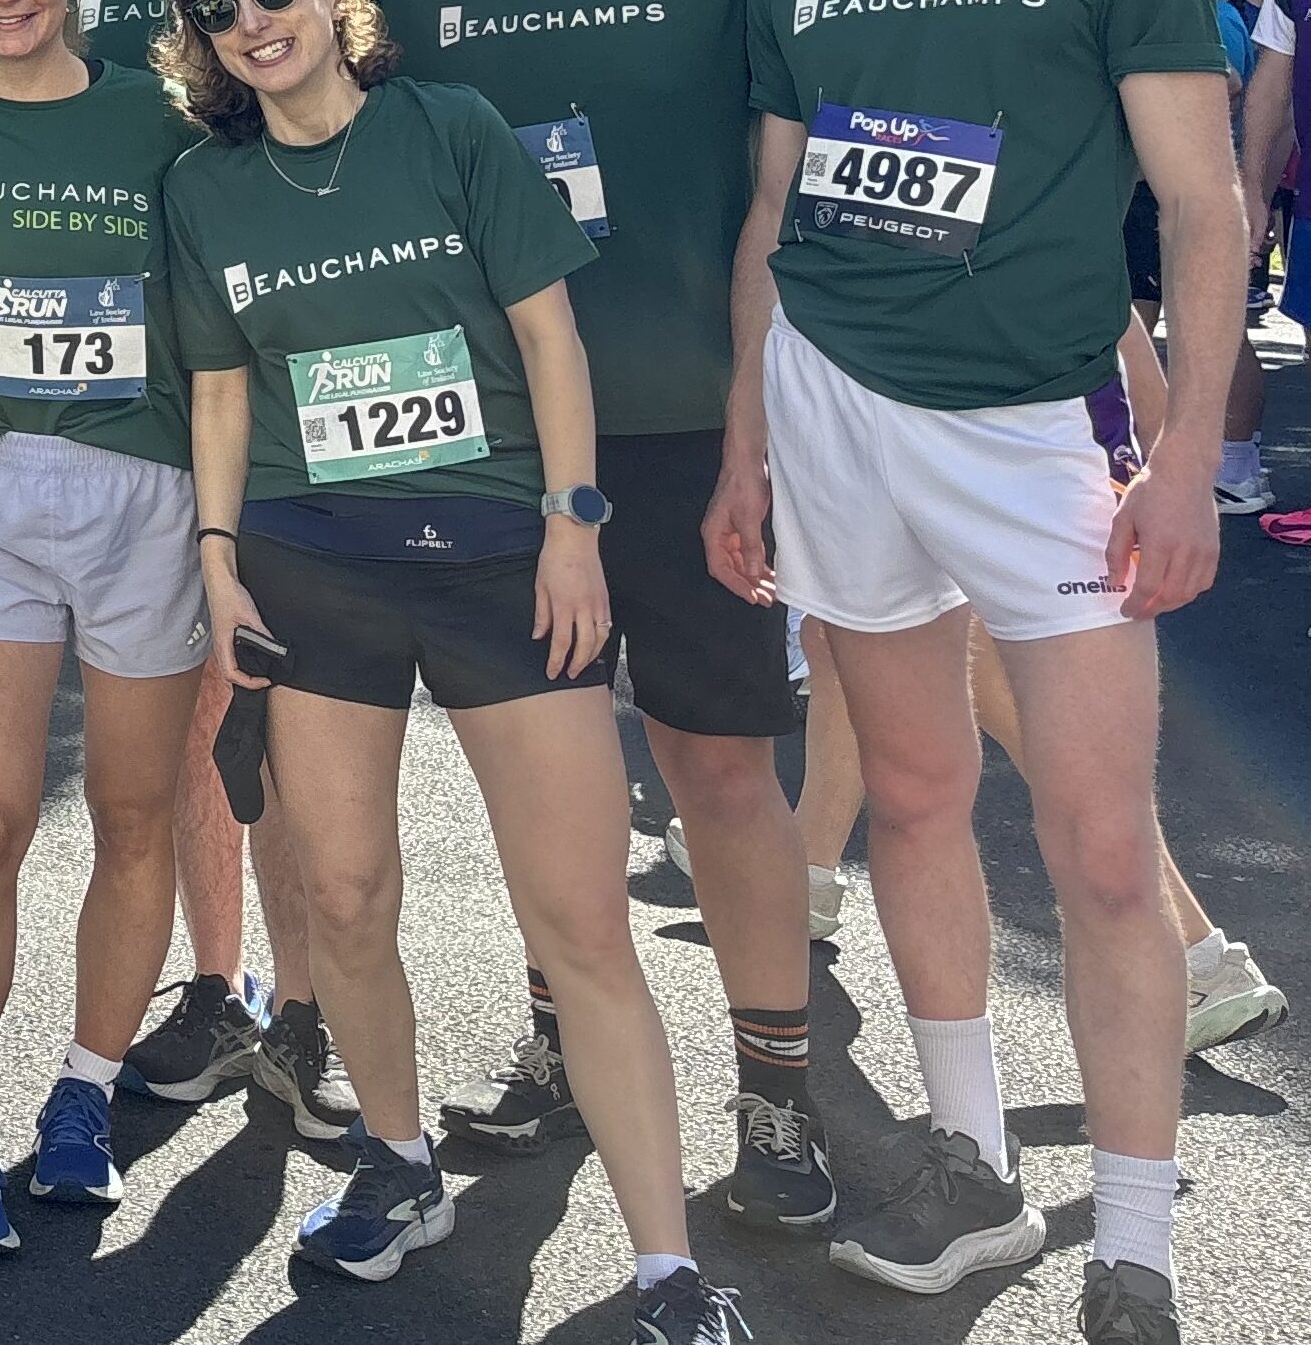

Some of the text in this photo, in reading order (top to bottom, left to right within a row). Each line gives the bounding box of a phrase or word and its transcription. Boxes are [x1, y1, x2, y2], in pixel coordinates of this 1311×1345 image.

[82, 0, 165, 26] BEAU
[443, 3, 666, 40] BEAUCHAMPS
[850, 111, 919, 142] Pop Up
[831, 147, 981, 214] 4987
[12, 209, 149, 240] SIDE BY SIDE
[839, 212, 950, 242] PEUGEOT
[233, 234, 464, 303] BEAUCHAMPS
[11, 288, 67, 299] CALCUTTA
[11, 298, 68, 317] RUN
[23, 332, 114, 375] 173
[333, 353, 390, 368] CALCUTTA
[336, 362, 392, 389] RUN
[338, 389, 466, 451] 1229
[405, 539, 453, 548] FLIPBELT
